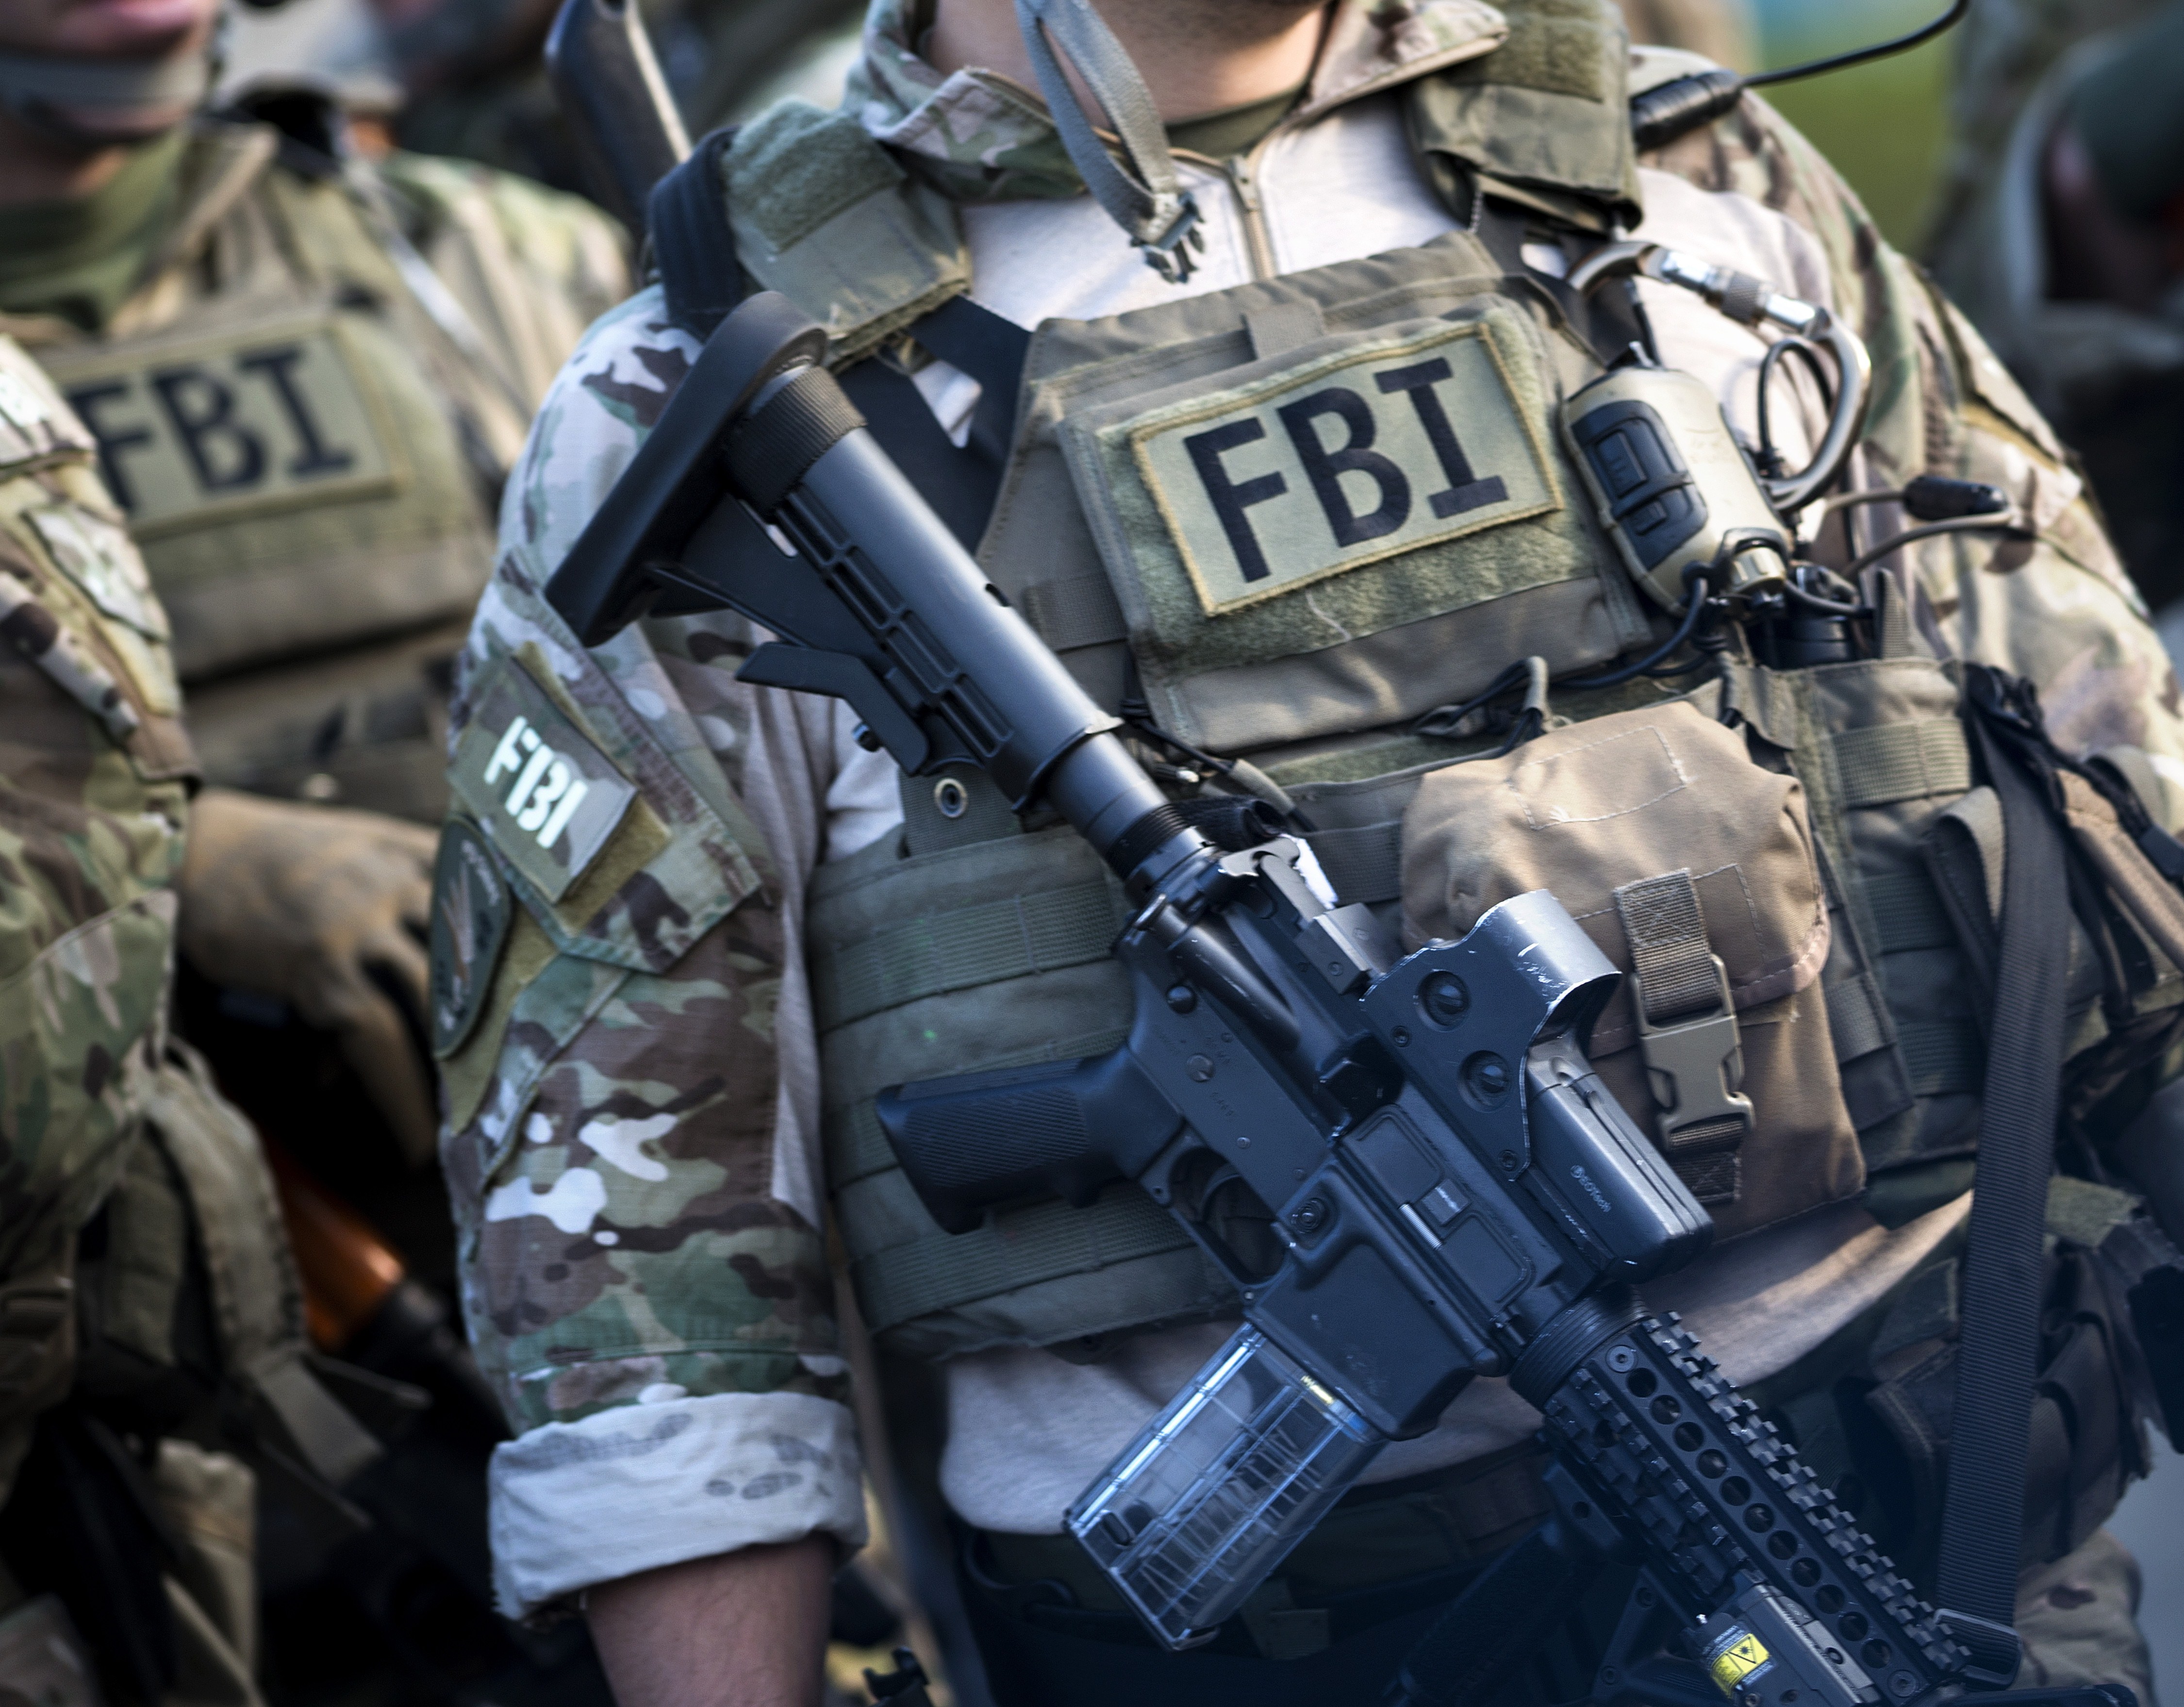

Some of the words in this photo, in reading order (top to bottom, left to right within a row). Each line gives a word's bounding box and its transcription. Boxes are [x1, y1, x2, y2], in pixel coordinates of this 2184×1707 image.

[69, 342, 355, 515] FBI
[1183, 357, 1508, 582] FBI
[485, 715, 588, 848] FBI
